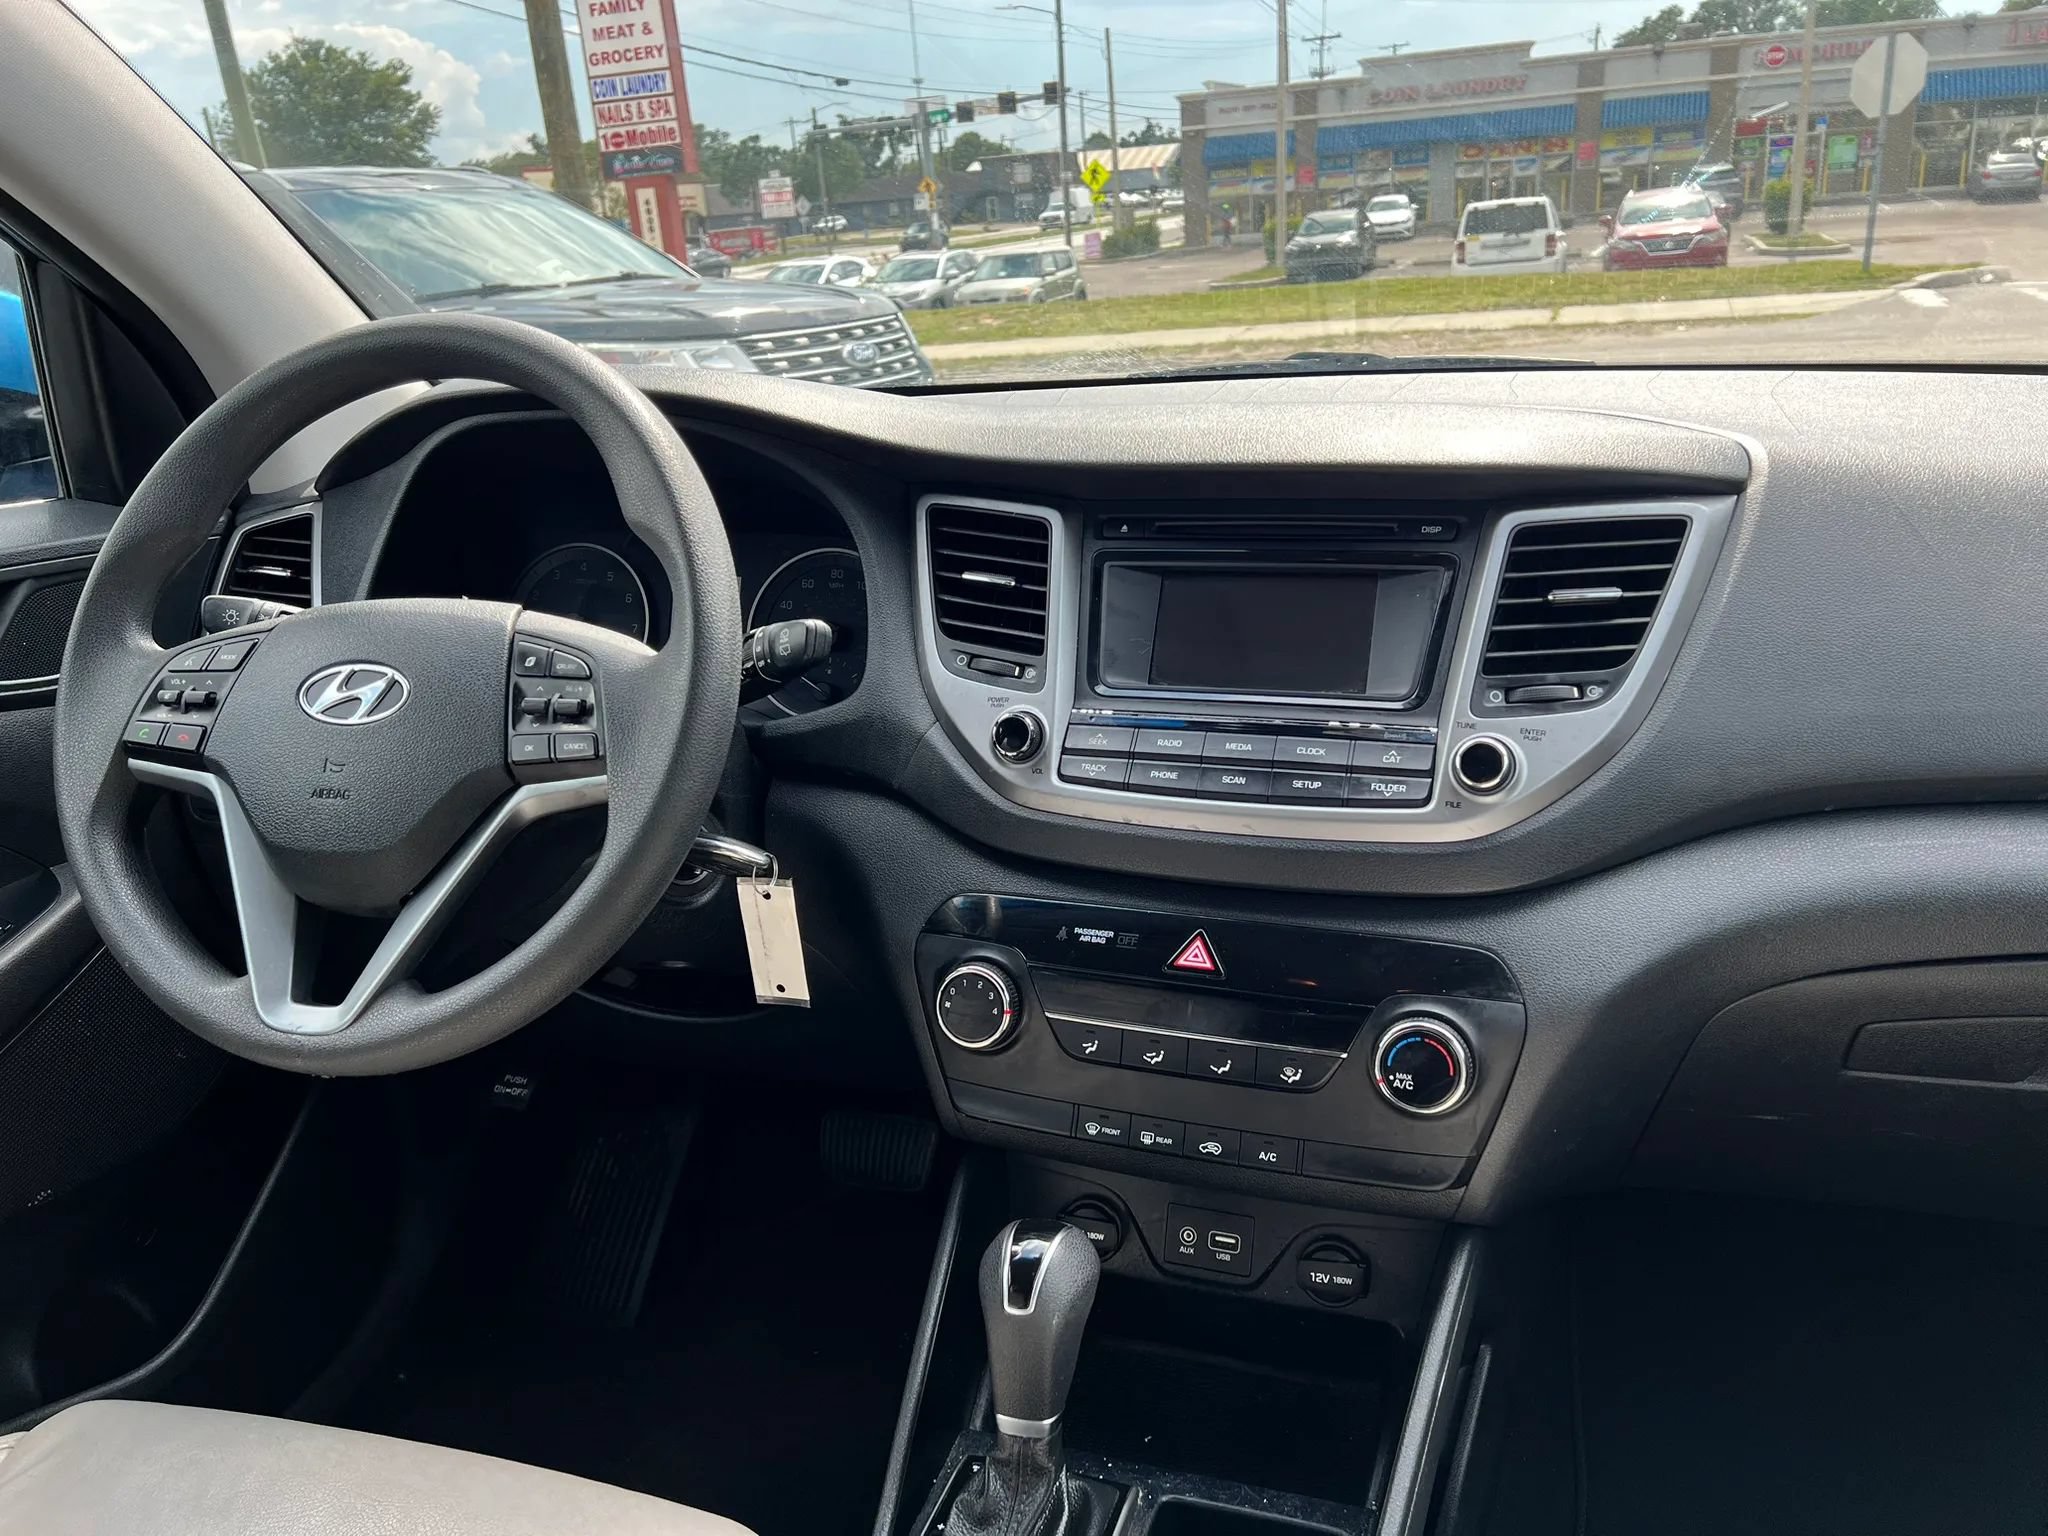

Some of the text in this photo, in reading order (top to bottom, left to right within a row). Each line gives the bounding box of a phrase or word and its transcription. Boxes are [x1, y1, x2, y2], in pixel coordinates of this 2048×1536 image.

[588, 0, 645, 17] FAMILY
[592, 22, 653, 42] MEAT &
[589, 44, 664, 66] GROCERY
[593, 72, 667, 99] COIN LAUNDRY
[597, 98, 673, 124] NAILS & SPA
[625, 126, 677, 146] Mobile
[1421, 525, 1442, 534] DISP
[801, 579, 815, 589] 60
[780, 600, 793, 610] 40
[1456, 721, 1477, 730] TUNE
[1520, 727, 1546, 737] ENTER
[1088, 737, 1108, 746] SEEK
[1157, 738, 1183, 748] RADIO
[1225, 742, 1252, 752] MEDIA
[1296, 746, 1326, 756] CLOCK
[1382, 755, 1401, 764] CAT
[1081, 763, 1107, 773] TRACK
[1150, 770, 1178, 780] PHONE
[1221, 775, 1246, 785] SCAN
[1292, 779, 1322, 790] SETUP
[1370, 783, 1407, 793] FOLDER
[311, 789, 352, 800] AIRBAG
[1445, 801, 1462, 809] FILE
[1074, 927, 1114, 938] PASSENGER
[1079, 935, 1107, 944] AIR BAG
[1117, 936, 1138, 946] OFF
[962, 979, 967, 987] 1
[977, 981, 983, 989] 2
[949, 987, 956, 995] 0
[988, 992, 994, 1000] 3
[504, 1074, 528, 1085] PUSH
[1396, 1072, 1412, 1080] MAX
[1393, 1079, 1414, 1090] A/C
[1101, 1127, 1121, 1136] FRONT
[1155, 1136, 1173, 1145] REAR
[1258, 1151, 1277, 1162] A/C
[1179, 1245, 1194, 1255] AUX
[1216, 1253, 1231, 1262] USB
[1310, 1272, 1353, 1285] 12V 180W
